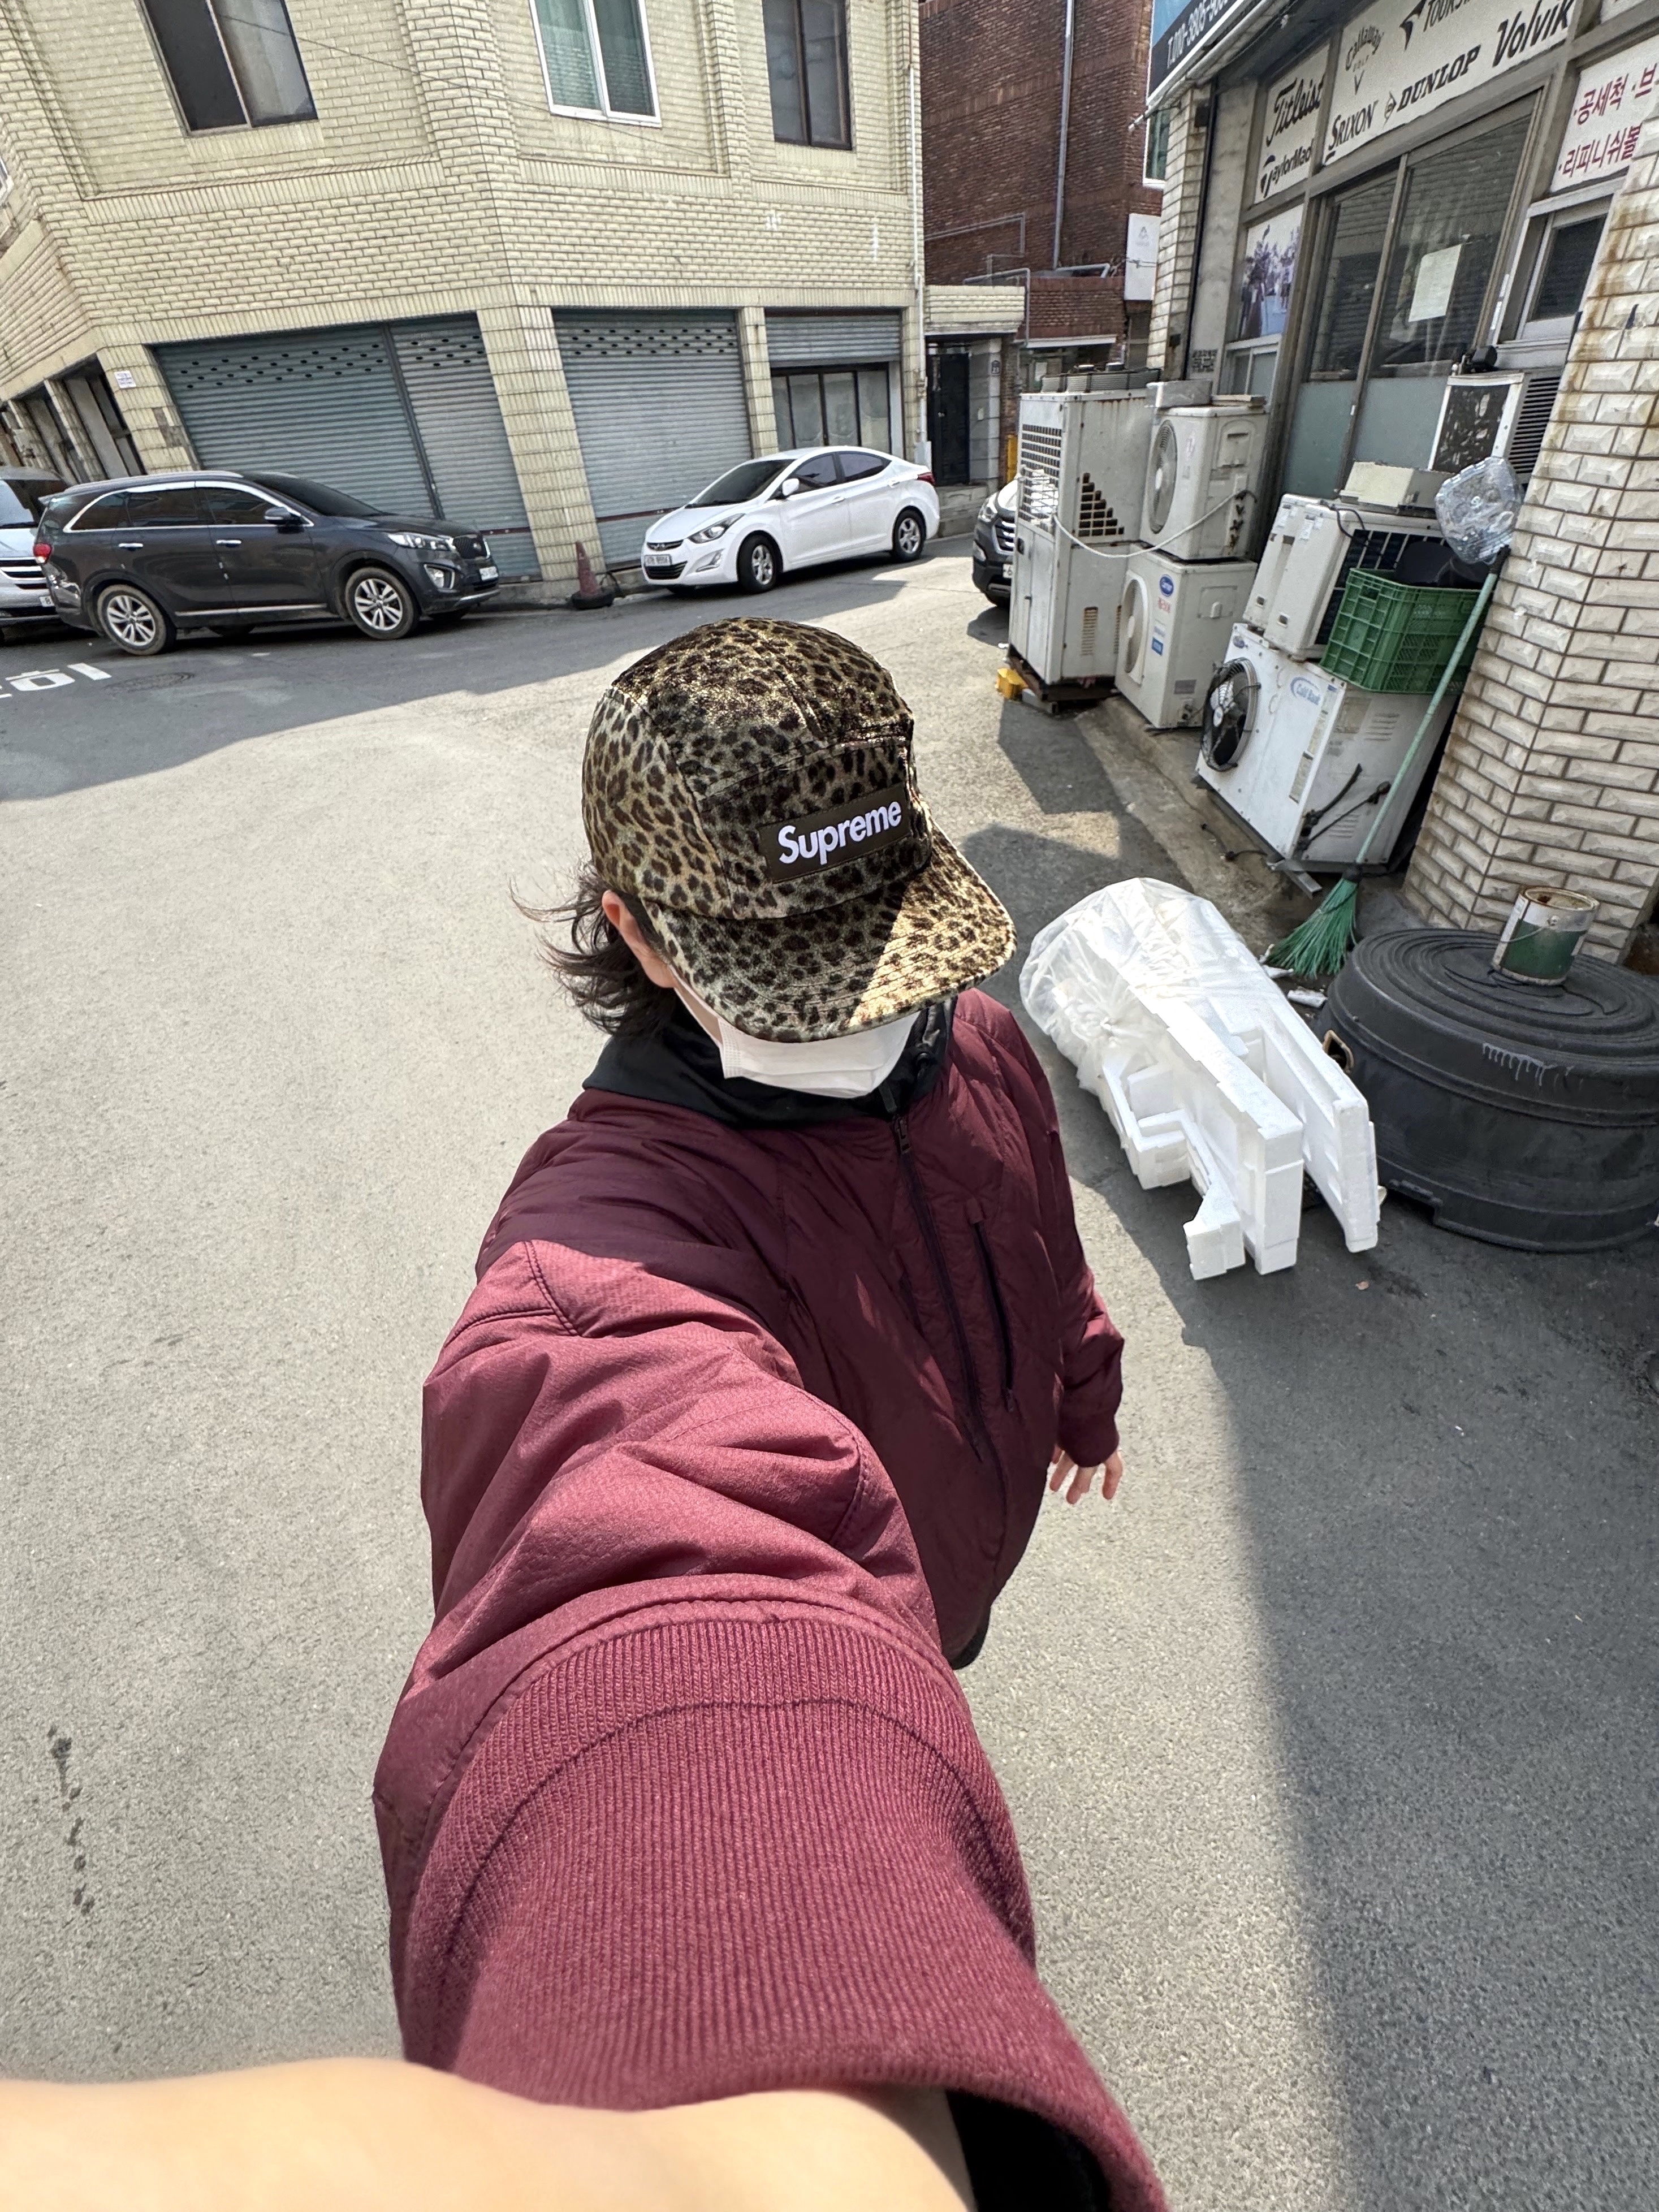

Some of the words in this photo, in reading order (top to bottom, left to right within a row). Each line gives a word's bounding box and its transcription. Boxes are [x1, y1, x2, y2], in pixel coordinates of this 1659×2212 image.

[1266, 72, 1326, 148] Titleist
[1397, 44, 1481, 112] DUNLOP
[778, 801, 901, 865] Supreme
